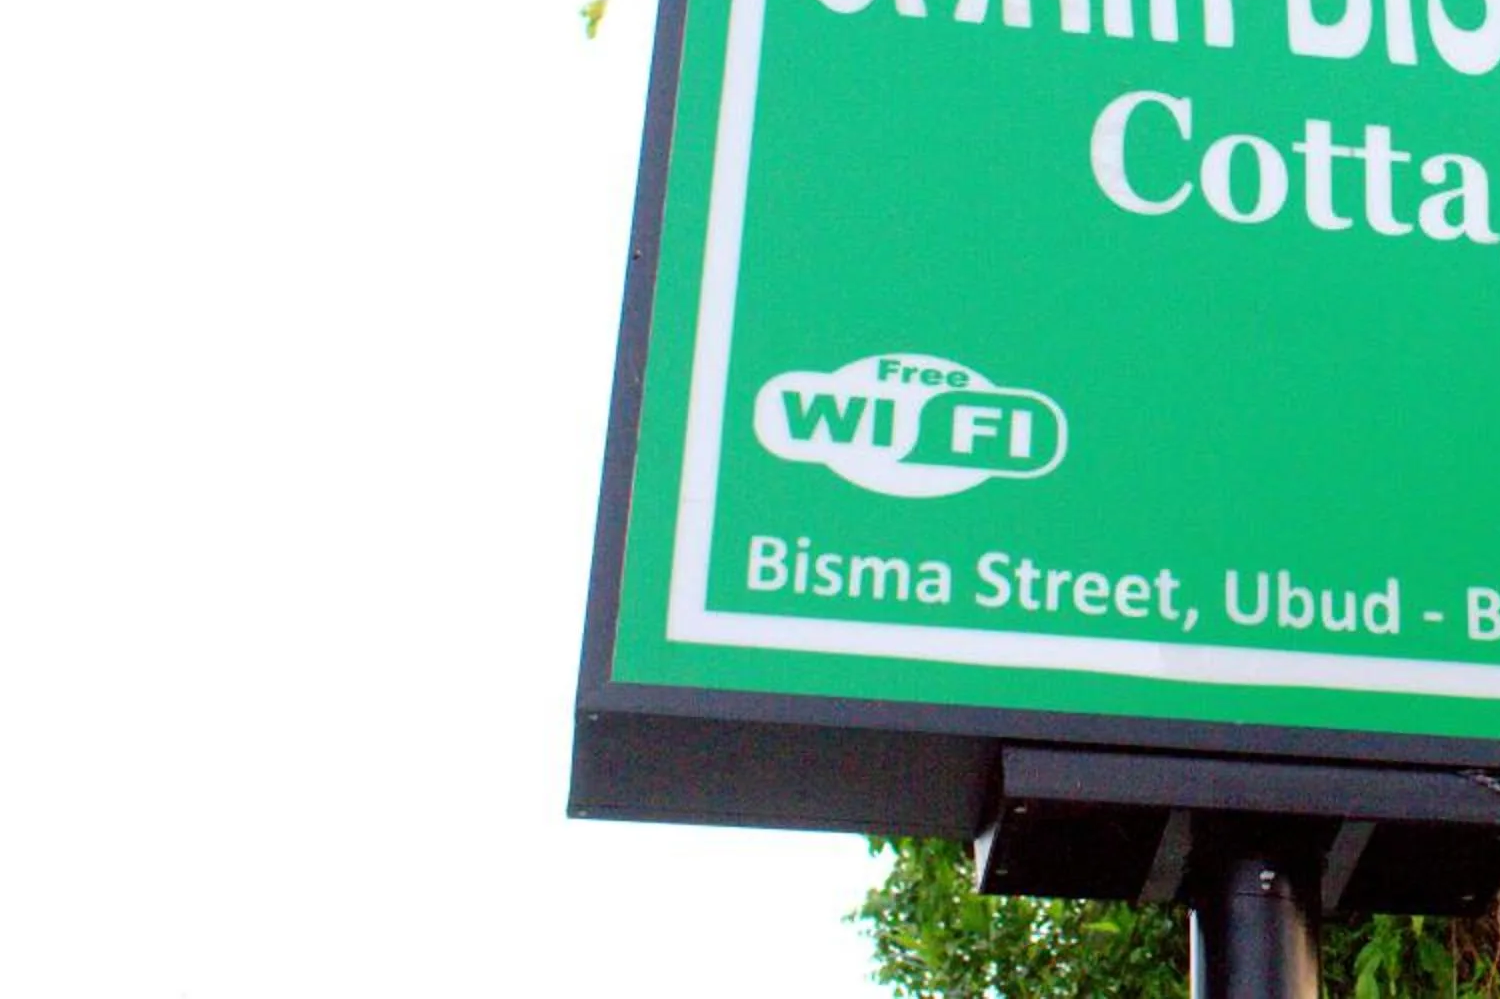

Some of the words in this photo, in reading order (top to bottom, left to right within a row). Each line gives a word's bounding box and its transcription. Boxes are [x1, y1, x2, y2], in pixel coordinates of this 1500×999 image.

[877, 359, 970, 388] Free
[747, 536, 951, 603] Bisma
[975, 553, 1197, 630] Street,
[1225, 571, 1399, 634] Ubud
